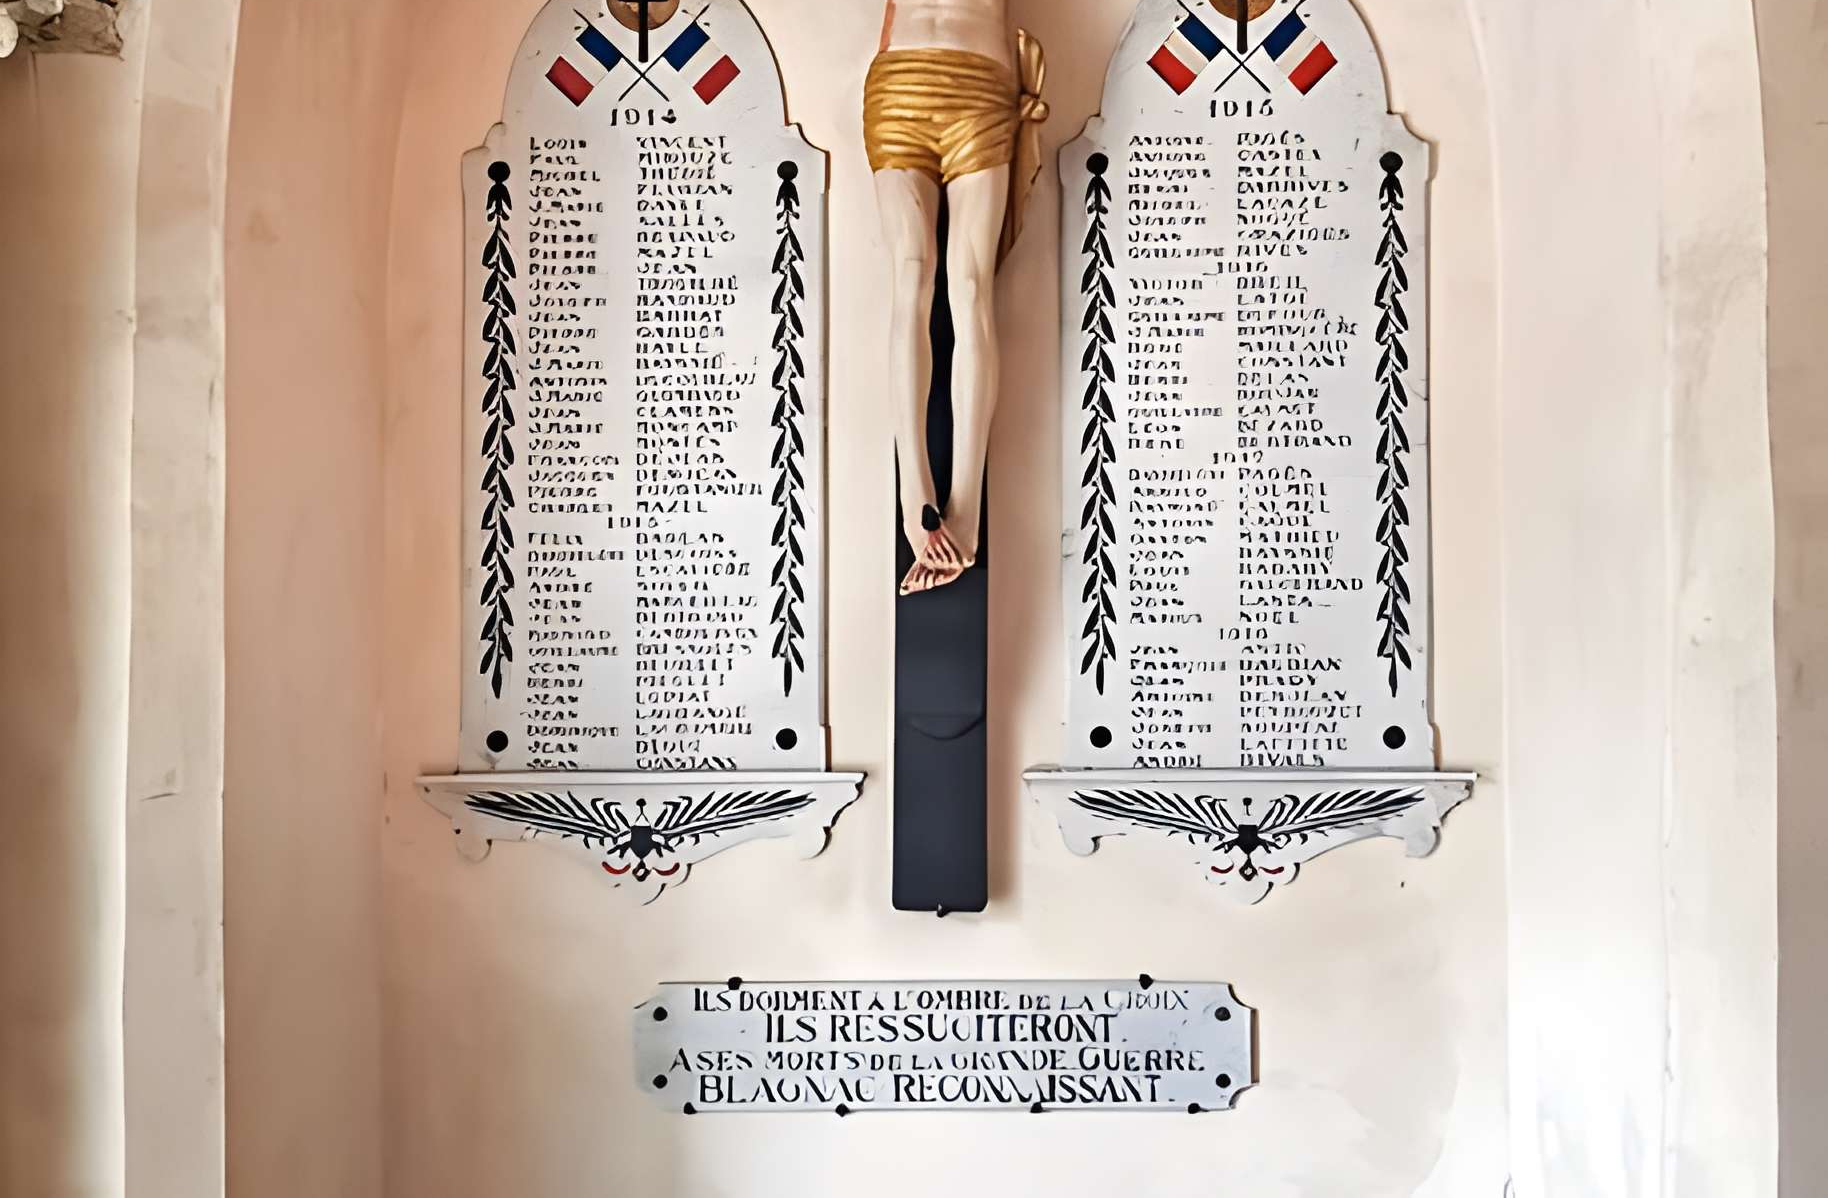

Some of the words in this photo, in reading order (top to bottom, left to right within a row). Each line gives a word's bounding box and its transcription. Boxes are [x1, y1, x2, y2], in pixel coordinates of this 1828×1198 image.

[695, 988, 731, 1011] ILS
[767, 1013, 817, 1043] ILS
[765, 1051, 866, 1071] MORTS
[1079, 1046, 1205, 1071] GUERRE
